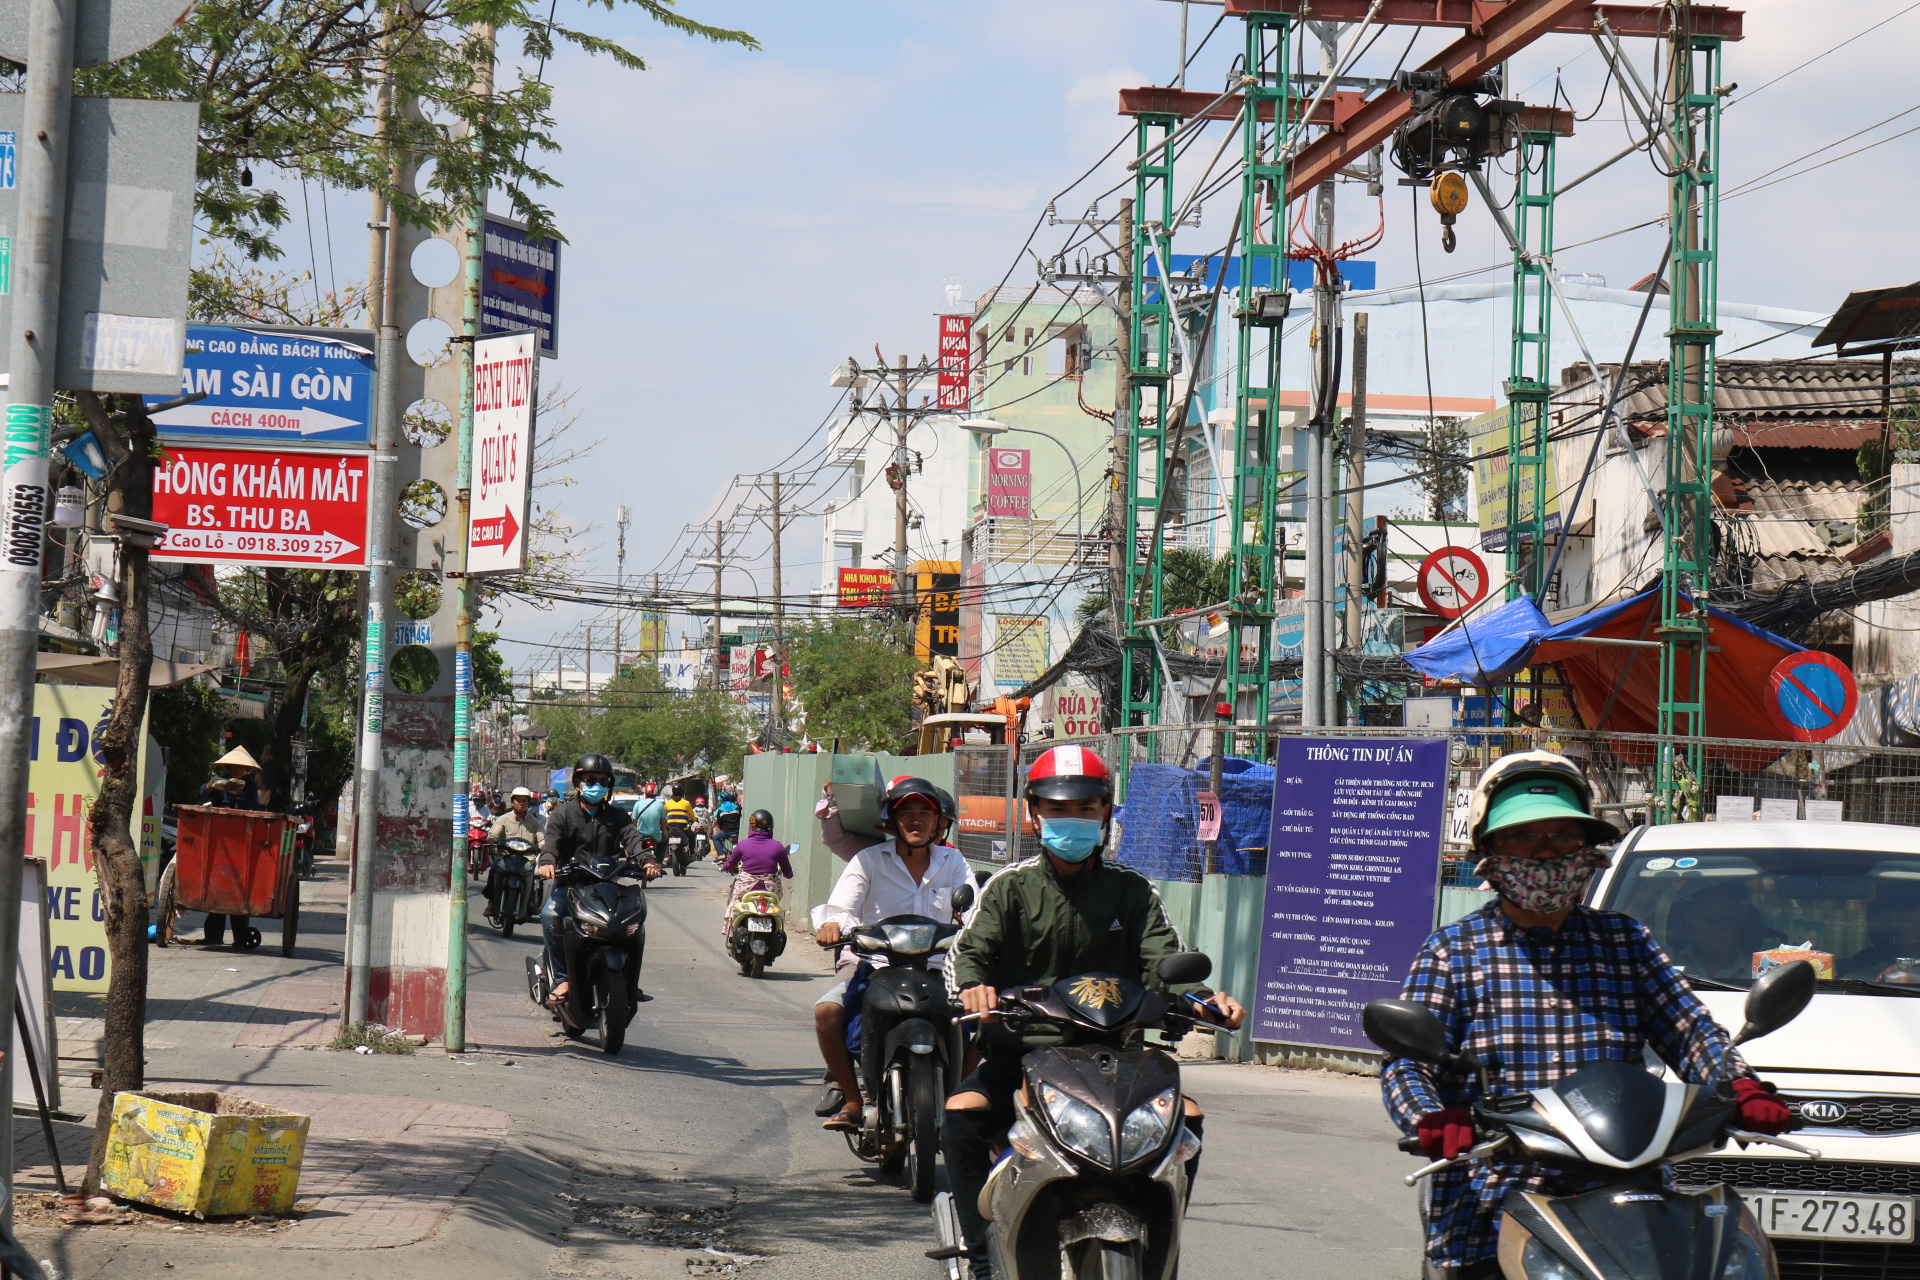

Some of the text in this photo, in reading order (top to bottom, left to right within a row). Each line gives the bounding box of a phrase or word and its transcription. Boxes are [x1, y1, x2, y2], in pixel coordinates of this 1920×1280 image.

[946, 319, 965, 332] NHA
[208, 340, 236, 354] CAO
[241, 336, 278, 356] ĐẲNG
[282, 341, 319, 358] BÁCH
[943, 337, 967, 350] KHOA
[943, 351, 966, 381] VIỆT
[231, 365, 280, 398] SÀI
[291, 367, 352, 401] GÒN
[476, 344, 531, 422] BỆNH VIỆN
[940, 381, 966, 405] PHÁP
[211, 409, 300, 429] CÁCH 400m
[3, 405, 40, 474] 0909 44
[481, 422, 516, 500] QUẬN 8
[154, 454, 363, 502] HÒNG KHÁM MẮT
[991, 473, 1028, 487] MORNING
[990, 495, 1028, 509] COFFEE
[7, 483, 45, 567] 0908761553
[187, 504, 310, 531] BS. THU BA
[172, 533, 201, 547] Cao
[205, 533, 224, 548] Lỗ
[237, 537, 310, 553] 0918.309
[314, 541, 342, 554] 257
[472, 528, 480, 542] 82
[481, 526, 494, 541] CAO
[844, 573, 877, 583] NHA KHOA
[395, 626, 431, 645] 37611454
[1059, 689, 1086, 714] RỬA
[369, 706, 382, 718] 757
[368, 719, 381, 734] 0909
[1065, 717, 1100, 735] ÔTÔ
[1307, 744, 1413, 765] THÔNG TIN DỰ ÁN
[1201, 803, 1215, 821] 570
[1365, 855, 1400, 863] CONSULTANT
[1808, 1104, 1839, 1117] KIA
[1740, 1196, 1906, 1236] 1F-273.48
